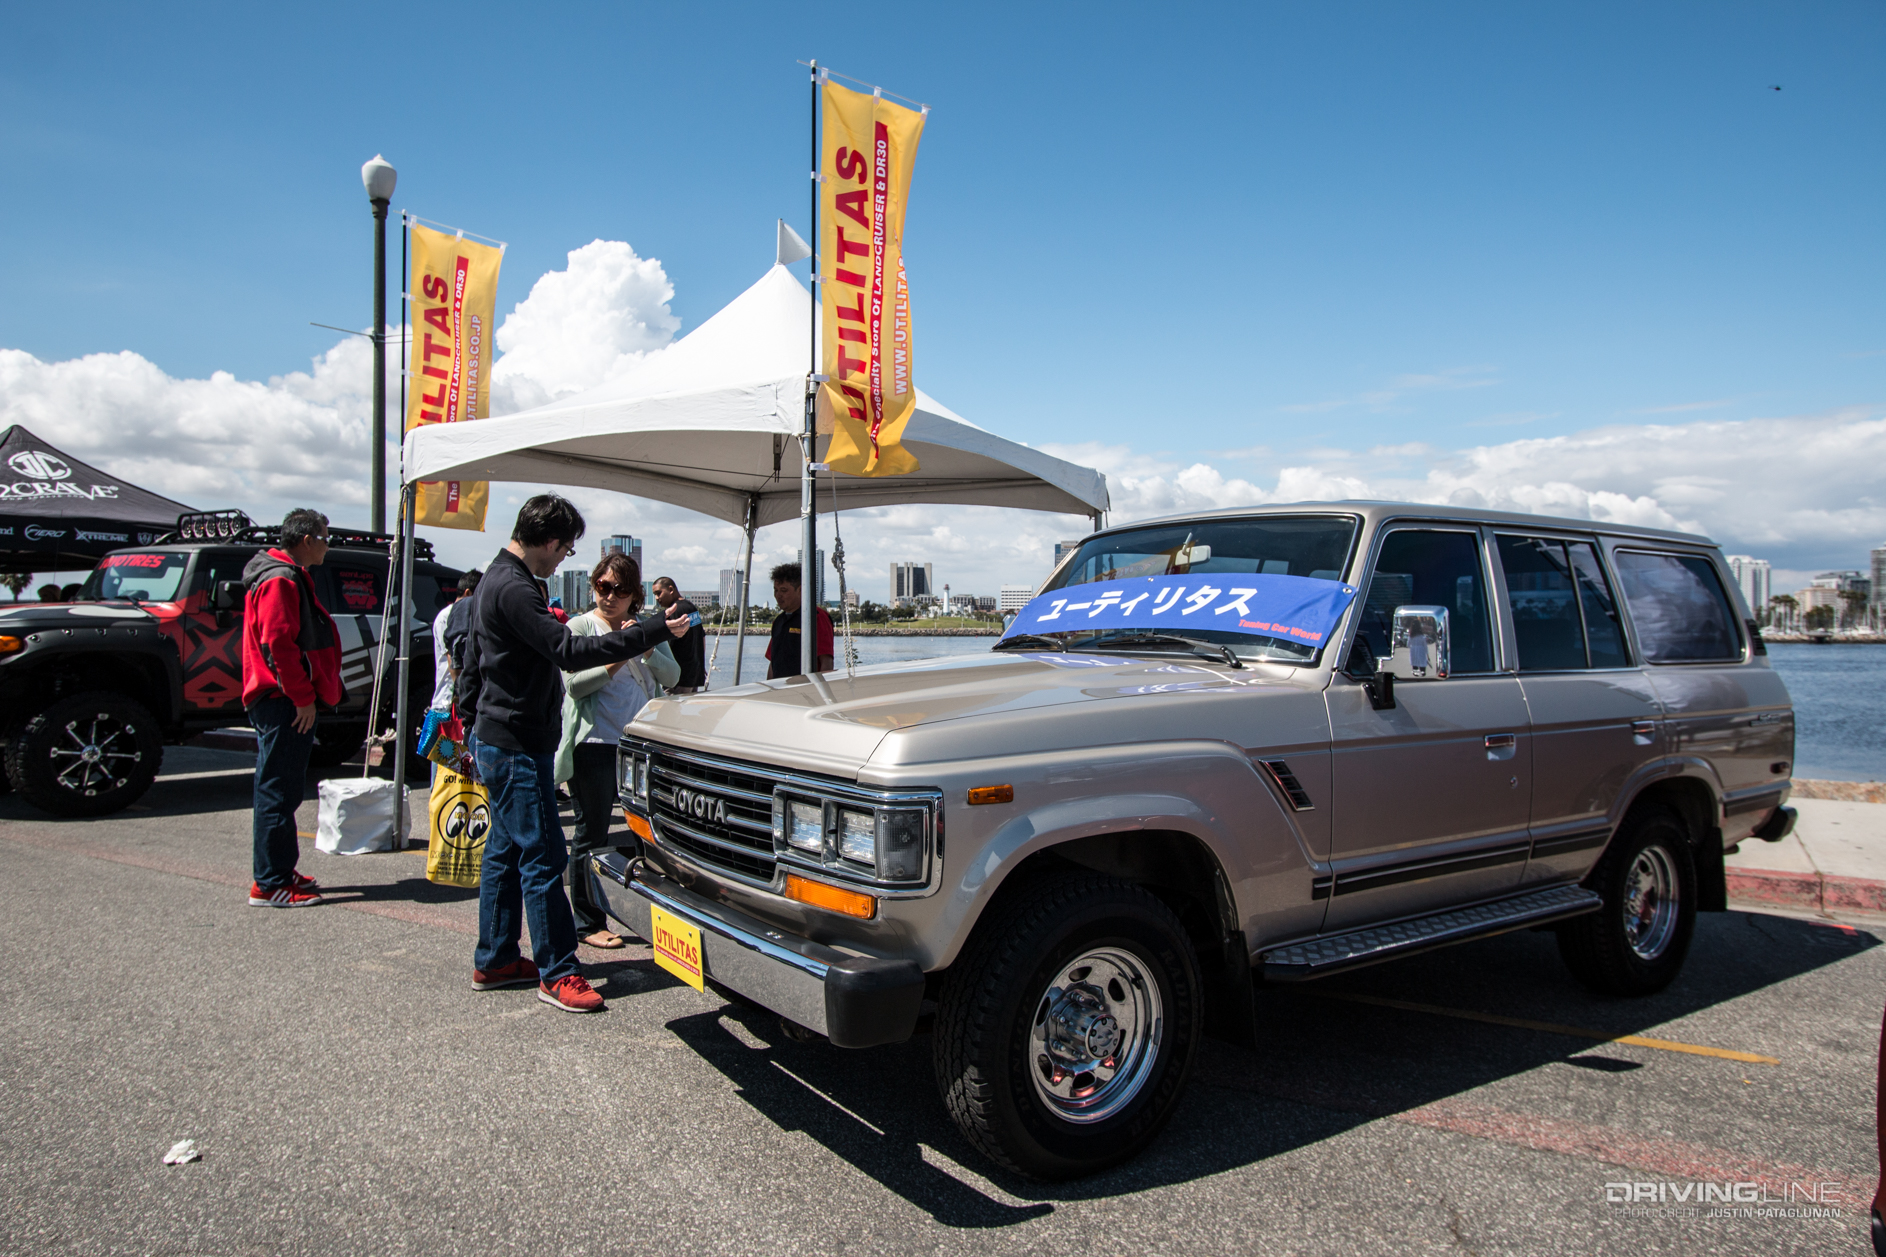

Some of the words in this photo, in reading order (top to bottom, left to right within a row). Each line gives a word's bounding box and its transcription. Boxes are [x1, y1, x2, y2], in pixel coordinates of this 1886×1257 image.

[876, 139, 887, 178] DR30
[875, 180, 886, 191] &
[873, 194, 885, 296] LANDCRUISER
[455, 269, 466, 299] DR30
[835, 146, 871, 423] UTILITAS
[872, 298, 882, 316] Of
[417, 274, 451, 427] ILITAS
[452, 310, 461, 388] LANDCRUISER
[871, 319, 880, 357] Store
[450, 389, 458, 402] Of
[449, 483, 458, 502] The
[74, 527, 130, 543] XTREME
[1037, 584, 1259, 622] ユーティリタス
[1238, 619, 1271, 631] Tuning
[1271, 623, 1290, 634] Car
[1290, 626, 1322, 641] World
[444, 775, 457, 784] GO!
[454, 811, 486, 821] MOON
[671, 785, 729, 824] TOYOTA
[655, 925, 699, 966] UTILITAS
